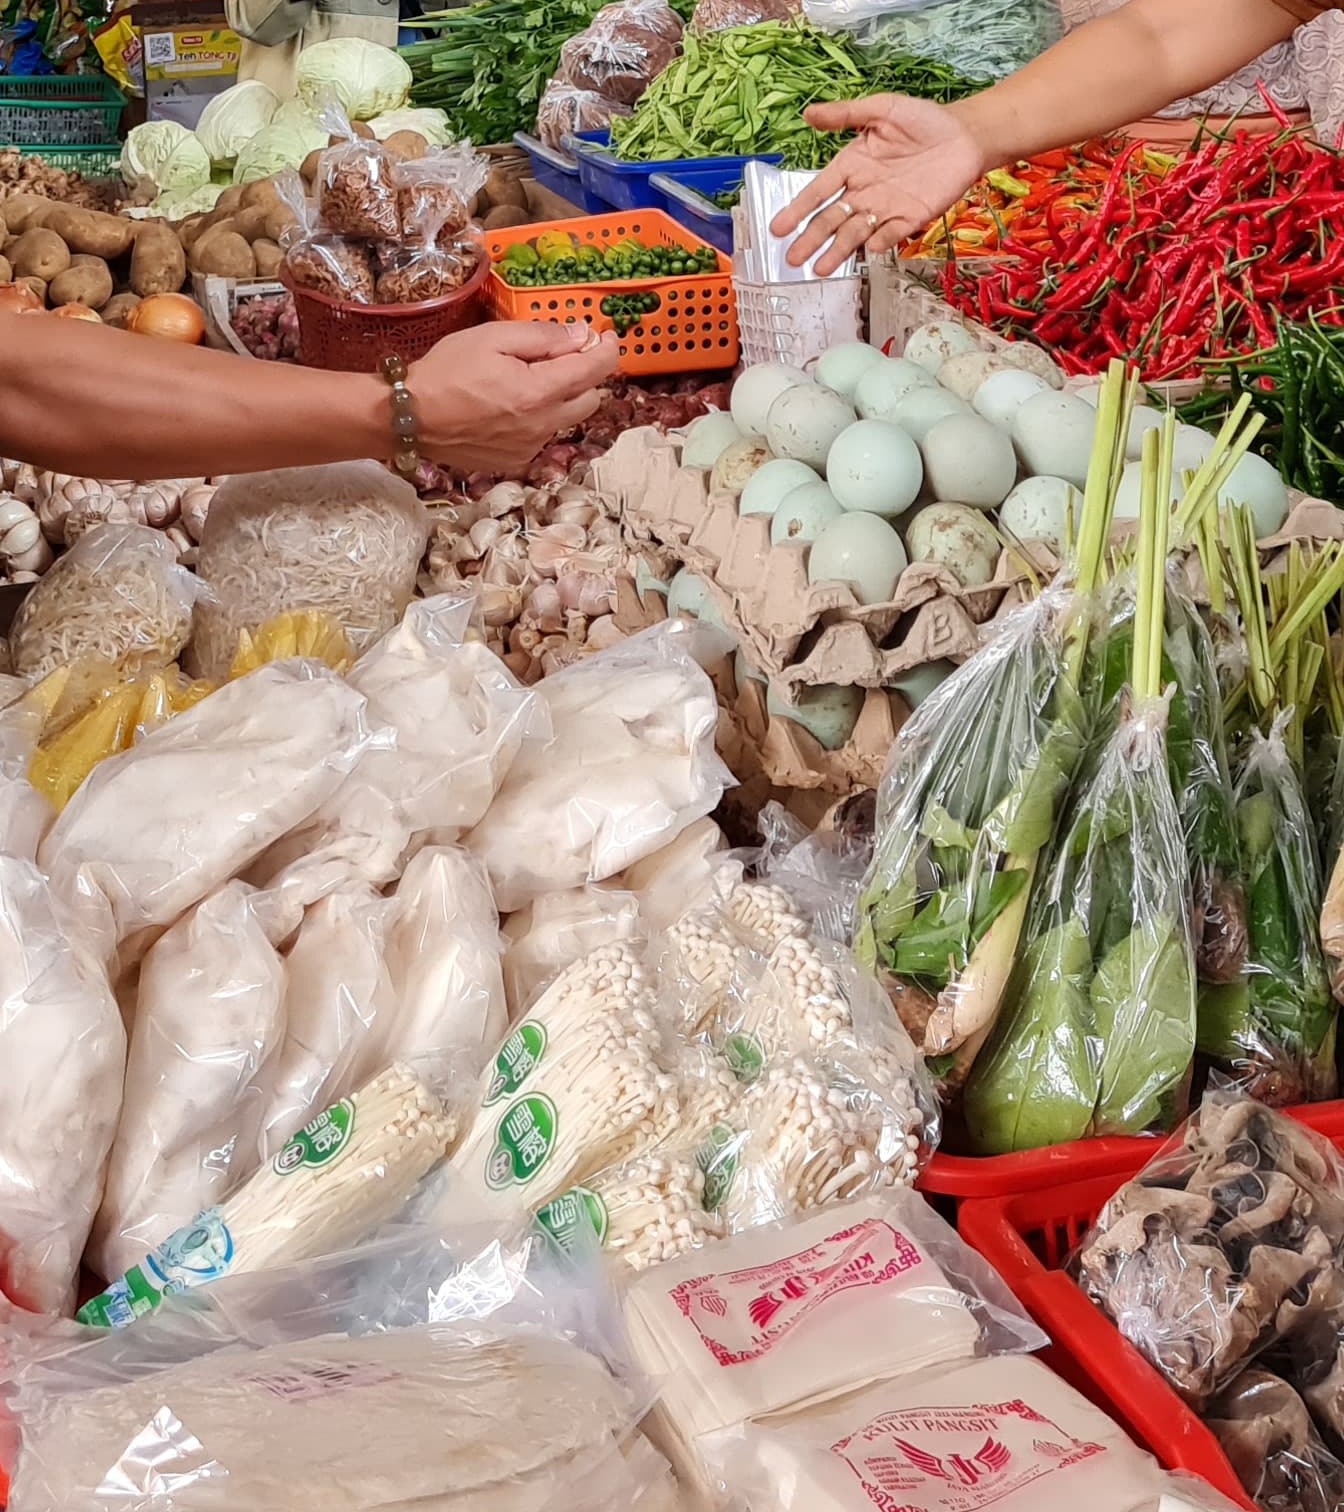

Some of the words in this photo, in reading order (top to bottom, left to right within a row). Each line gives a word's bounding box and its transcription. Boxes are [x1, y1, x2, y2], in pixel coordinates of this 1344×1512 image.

[198, 51, 224, 61] TONG
[506, 1101, 549, 1168] 雪榕
[863, 1419, 921, 1441] KULIT
[924, 1417, 1001, 1433] PANGSIT
